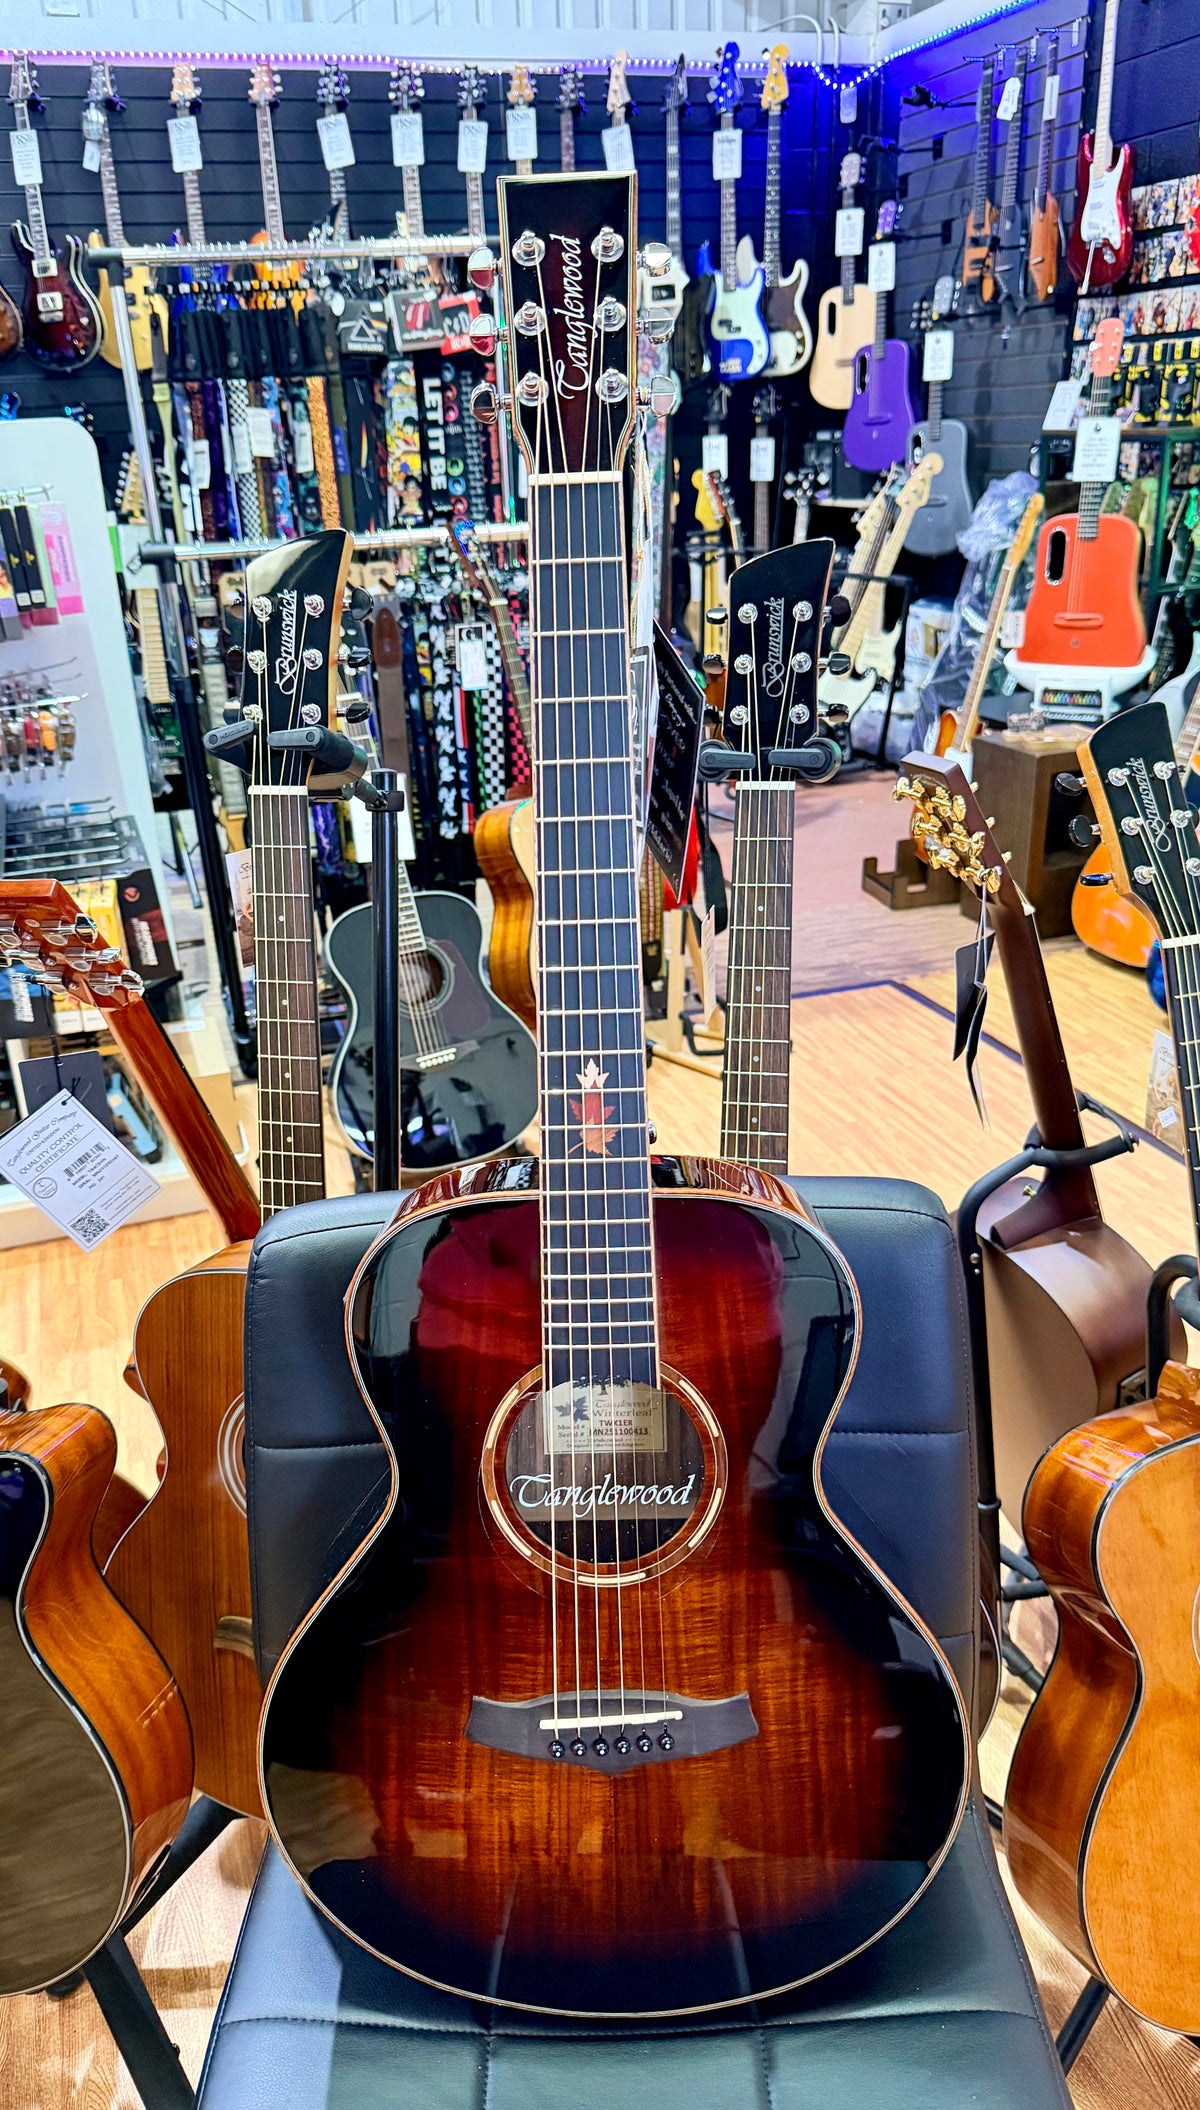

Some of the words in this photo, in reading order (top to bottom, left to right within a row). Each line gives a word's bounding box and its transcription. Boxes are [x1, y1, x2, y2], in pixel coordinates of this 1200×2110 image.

[549, 233, 598, 400] Tanglewood
[422, 377, 445, 426] LET
[426, 427, 446, 455] IT
[429, 456, 448, 491] BE
[274, 588, 298, 695] Brunswick
[761, 597, 785, 698] Brunswick
[1125, 757, 1172, 852] Brunswick
[19, 1148, 51, 1175] QUALITY
[49, 1122, 85, 1151] CONTROL
[35, 1135, 81, 1173] CERTIFICATE
[509, 1473, 696, 1519] Tanglewood
